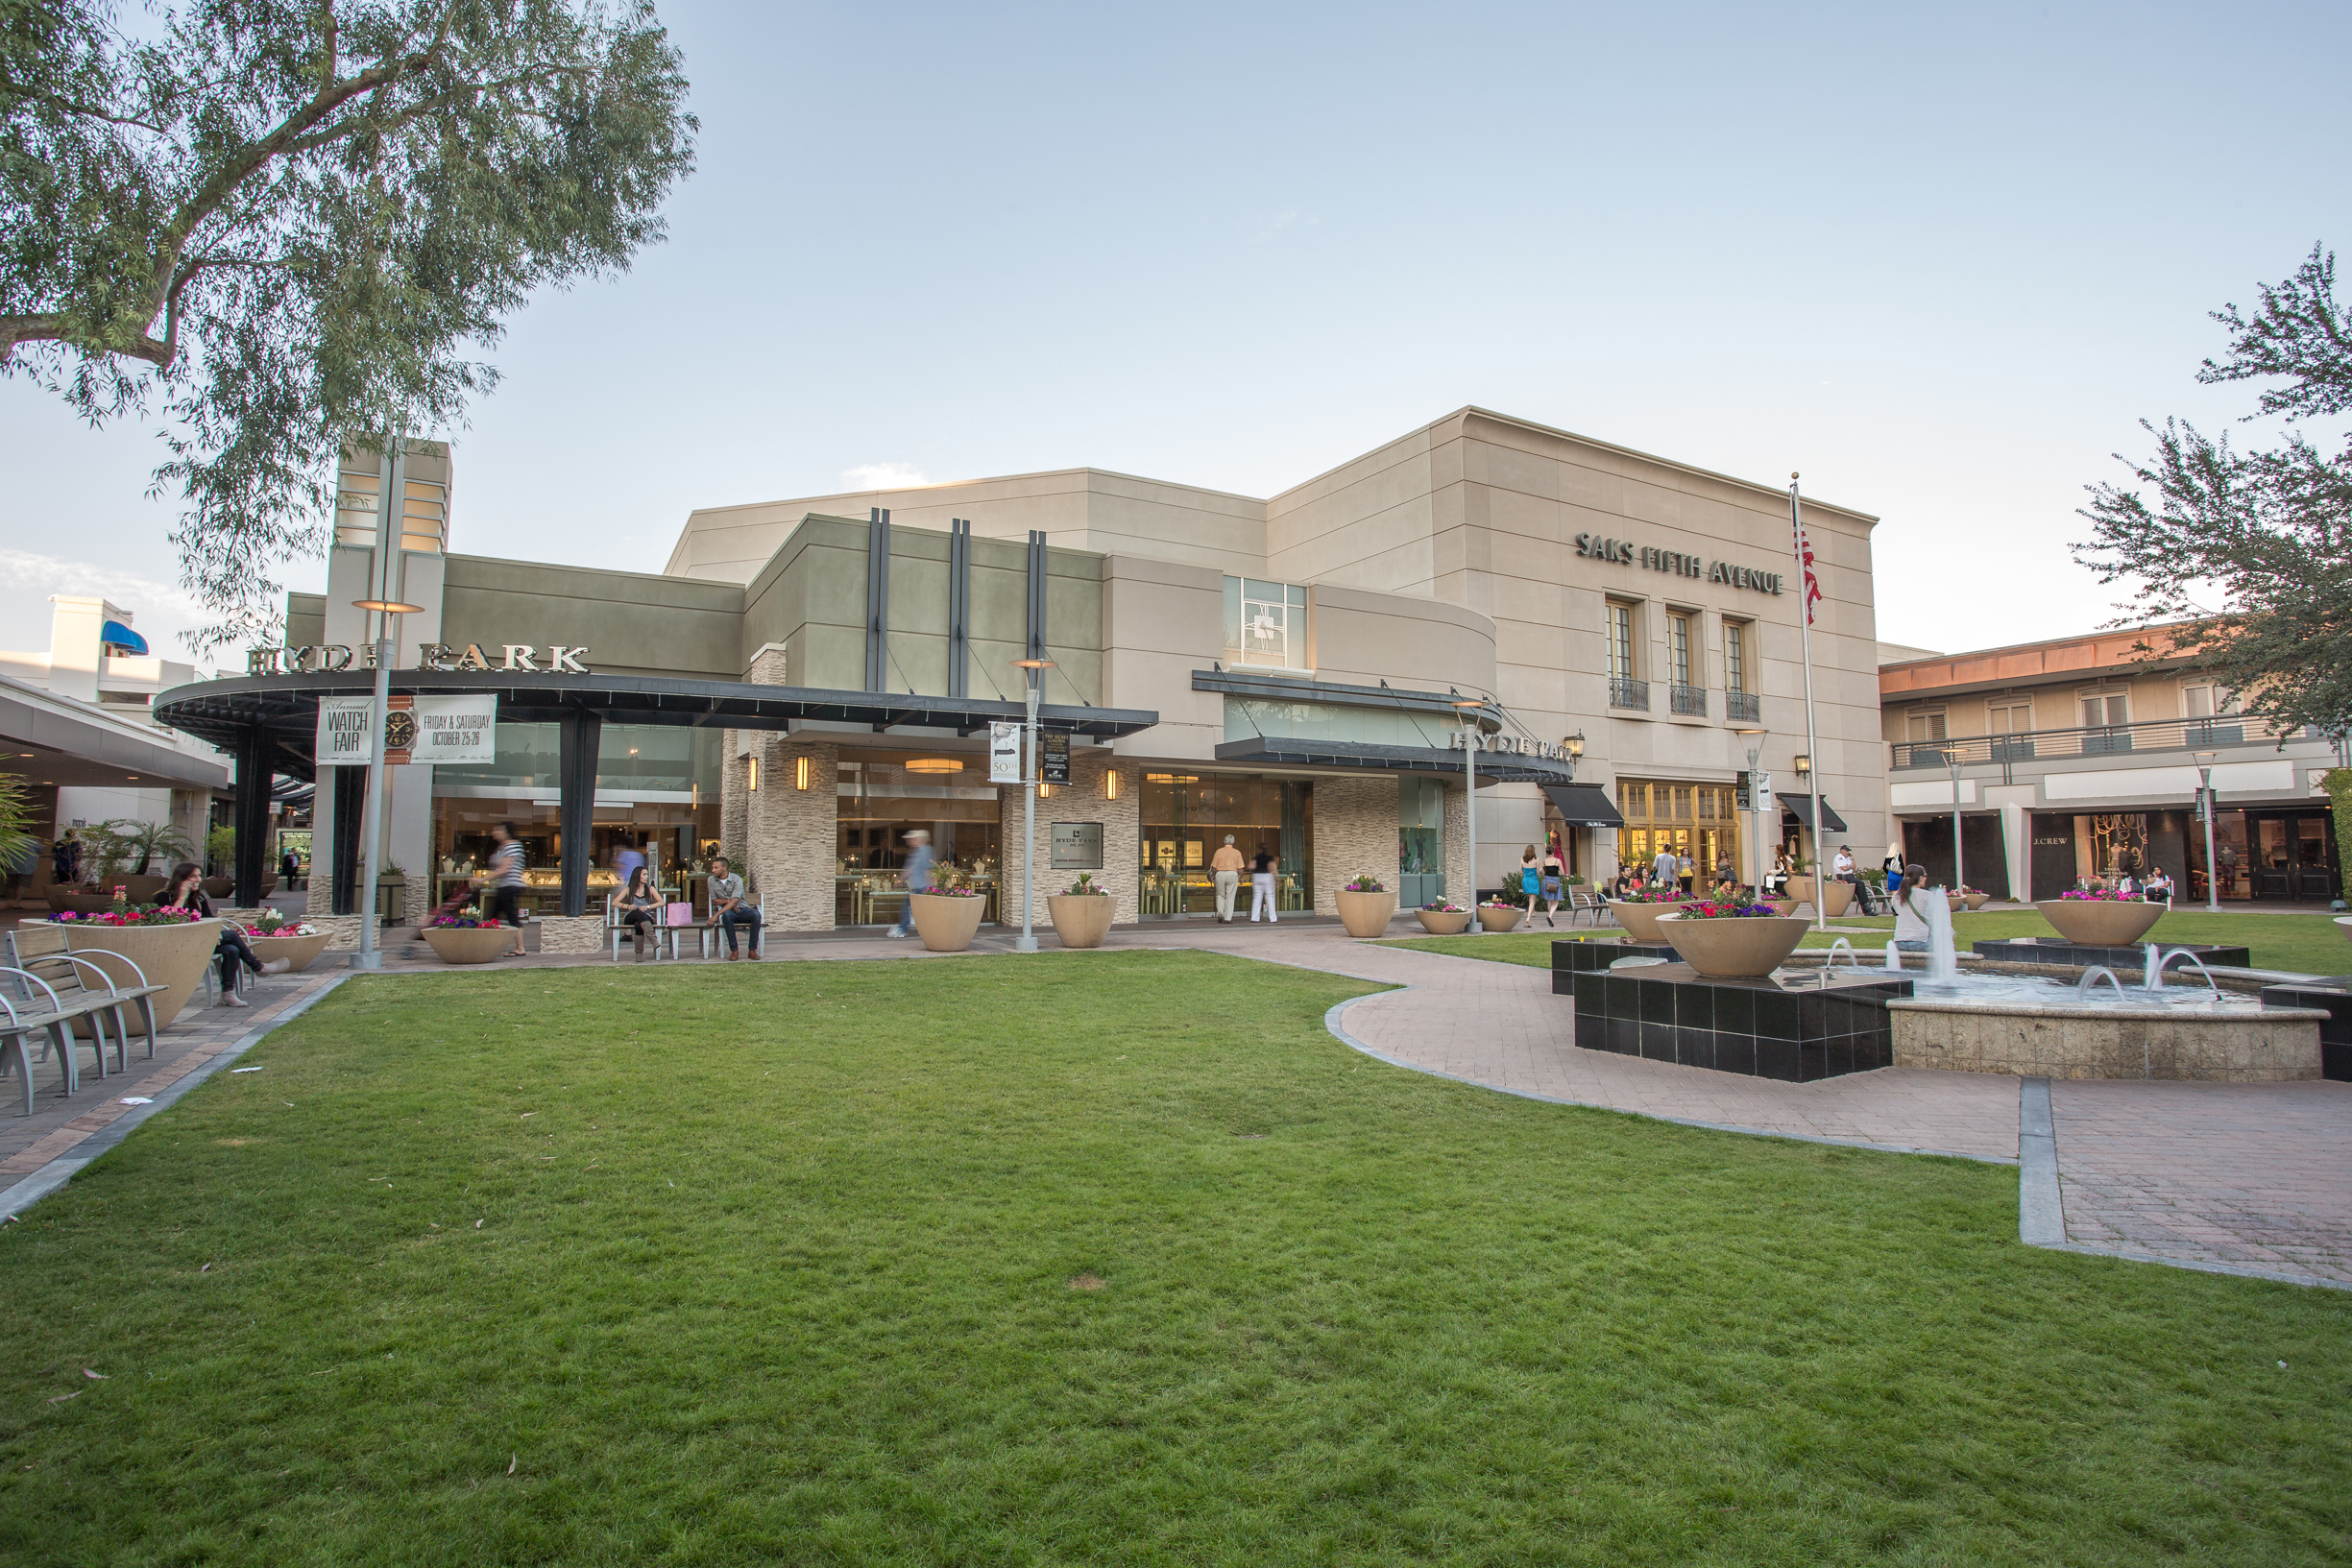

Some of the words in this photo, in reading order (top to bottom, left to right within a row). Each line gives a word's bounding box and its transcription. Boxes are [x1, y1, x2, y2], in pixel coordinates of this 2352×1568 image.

[1576, 532, 1635, 565] SAKS
[1640, 545, 1702, 578] FIFTH
[1708, 560, 1785, 595] AVENUE
[246, 644, 378, 675] HYDE
[417, 642, 591, 673] PARK
[327, 700, 372, 710] Annual
[327, 712, 368, 732] WATCH
[424, 715, 448, 730] FRIDAY
[449, 715, 454, 730] &
[455, 714, 491, 730] SATURDAY
[334, 732, 360, 752] FAIR
[432, 732, 460, 746] OCTOBER
[461, 732, 480, 746] 25-26
[1448, 732, 1532, 755] HYDE
[993, 761, 1018, 773] 50TH
